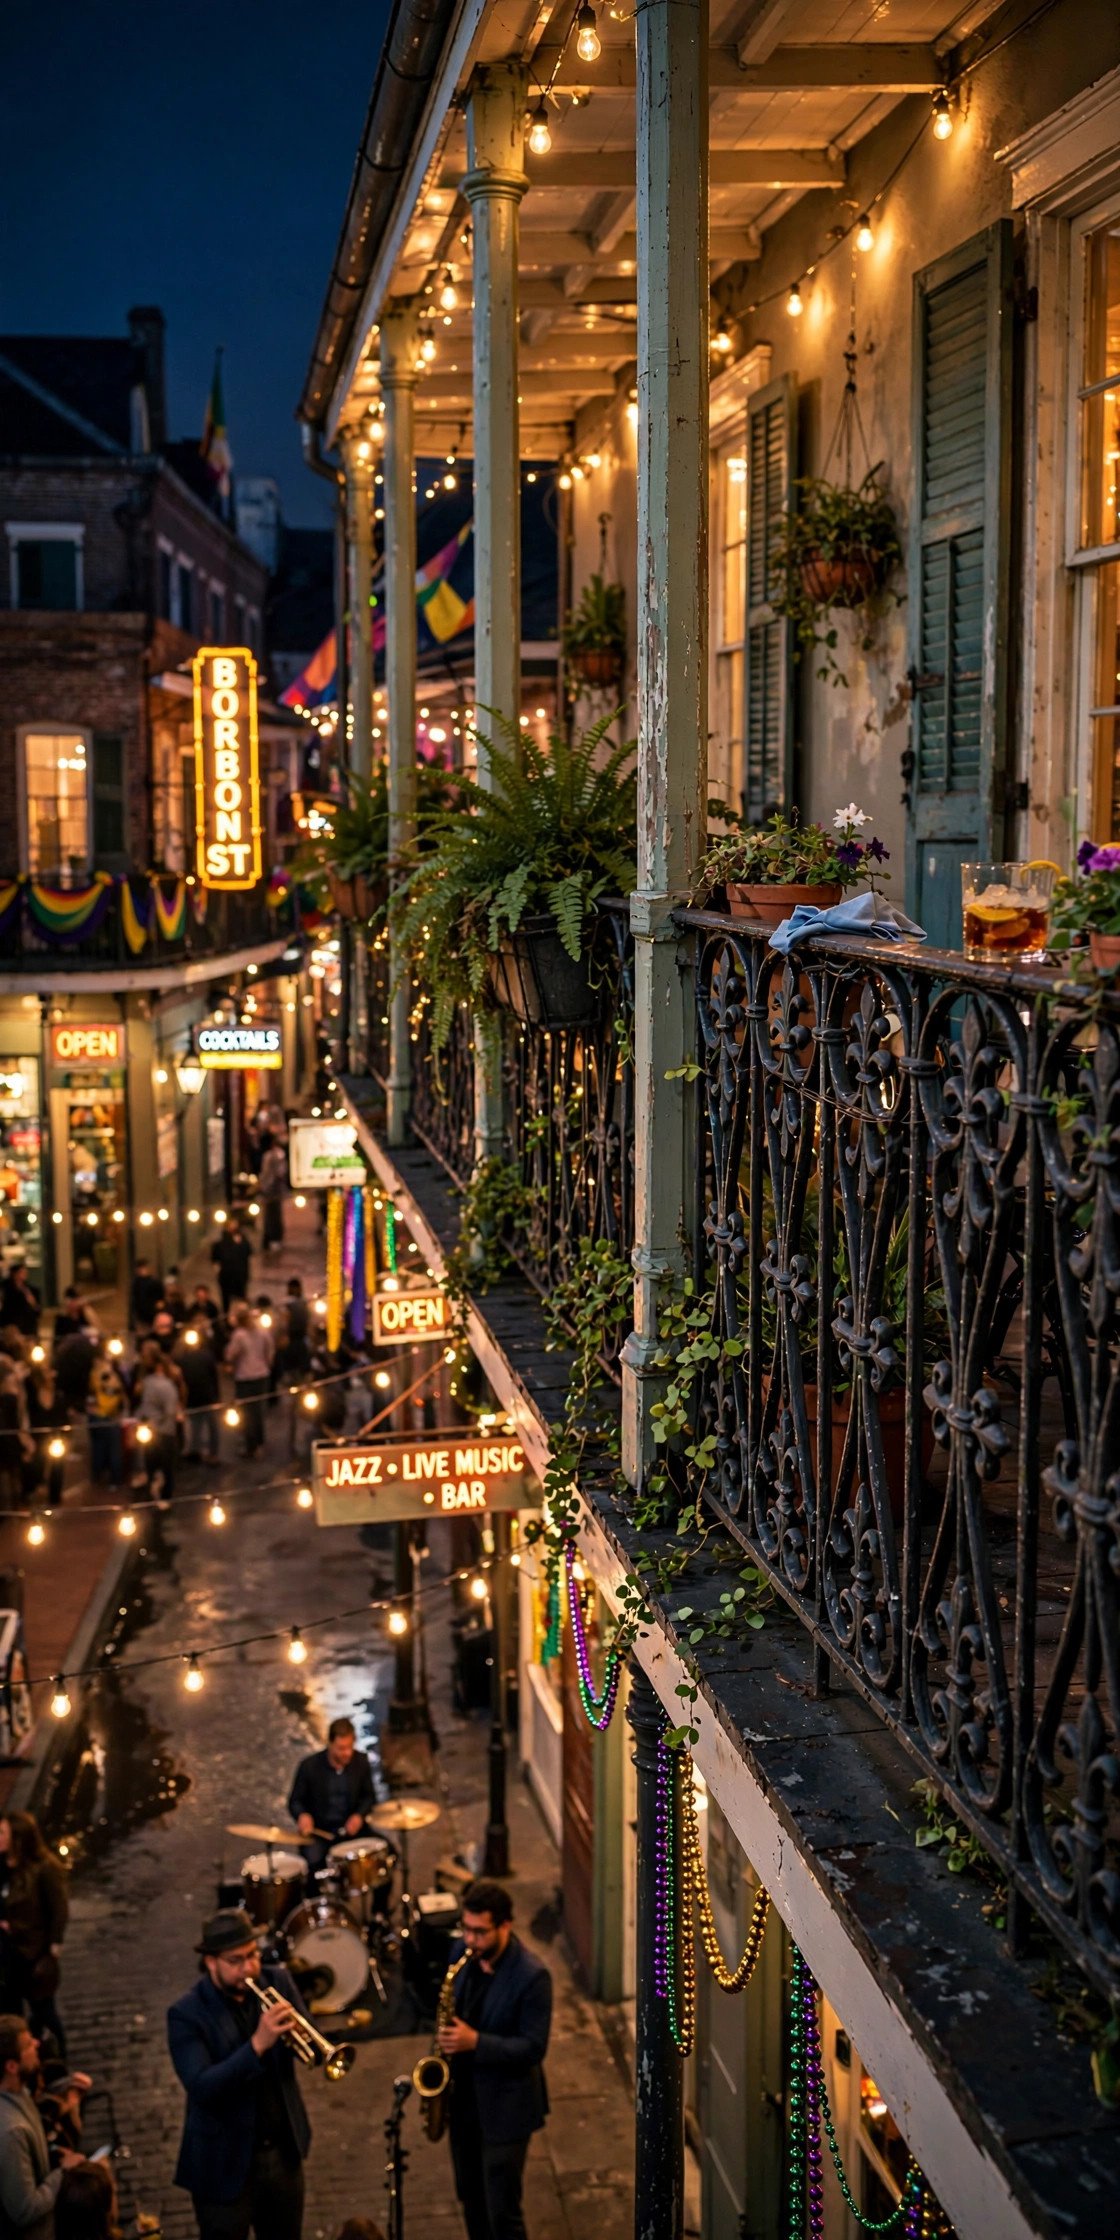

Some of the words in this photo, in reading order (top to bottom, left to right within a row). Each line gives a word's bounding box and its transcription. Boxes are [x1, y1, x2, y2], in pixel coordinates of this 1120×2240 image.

[211, 657, 242, 842] BORBON
[206, 843, 251, 876] ST
[56, 1030, 117, 1057] OPEN
[381, 1298, 443, 1330] OPEN
[325, 1456, 382, 1487] JAZZ
[402, 1451, 450, 1480] LIVE
[455, 1445, 524, 1476] MUSIC
[441, 1481, 486, 1510] BAR
